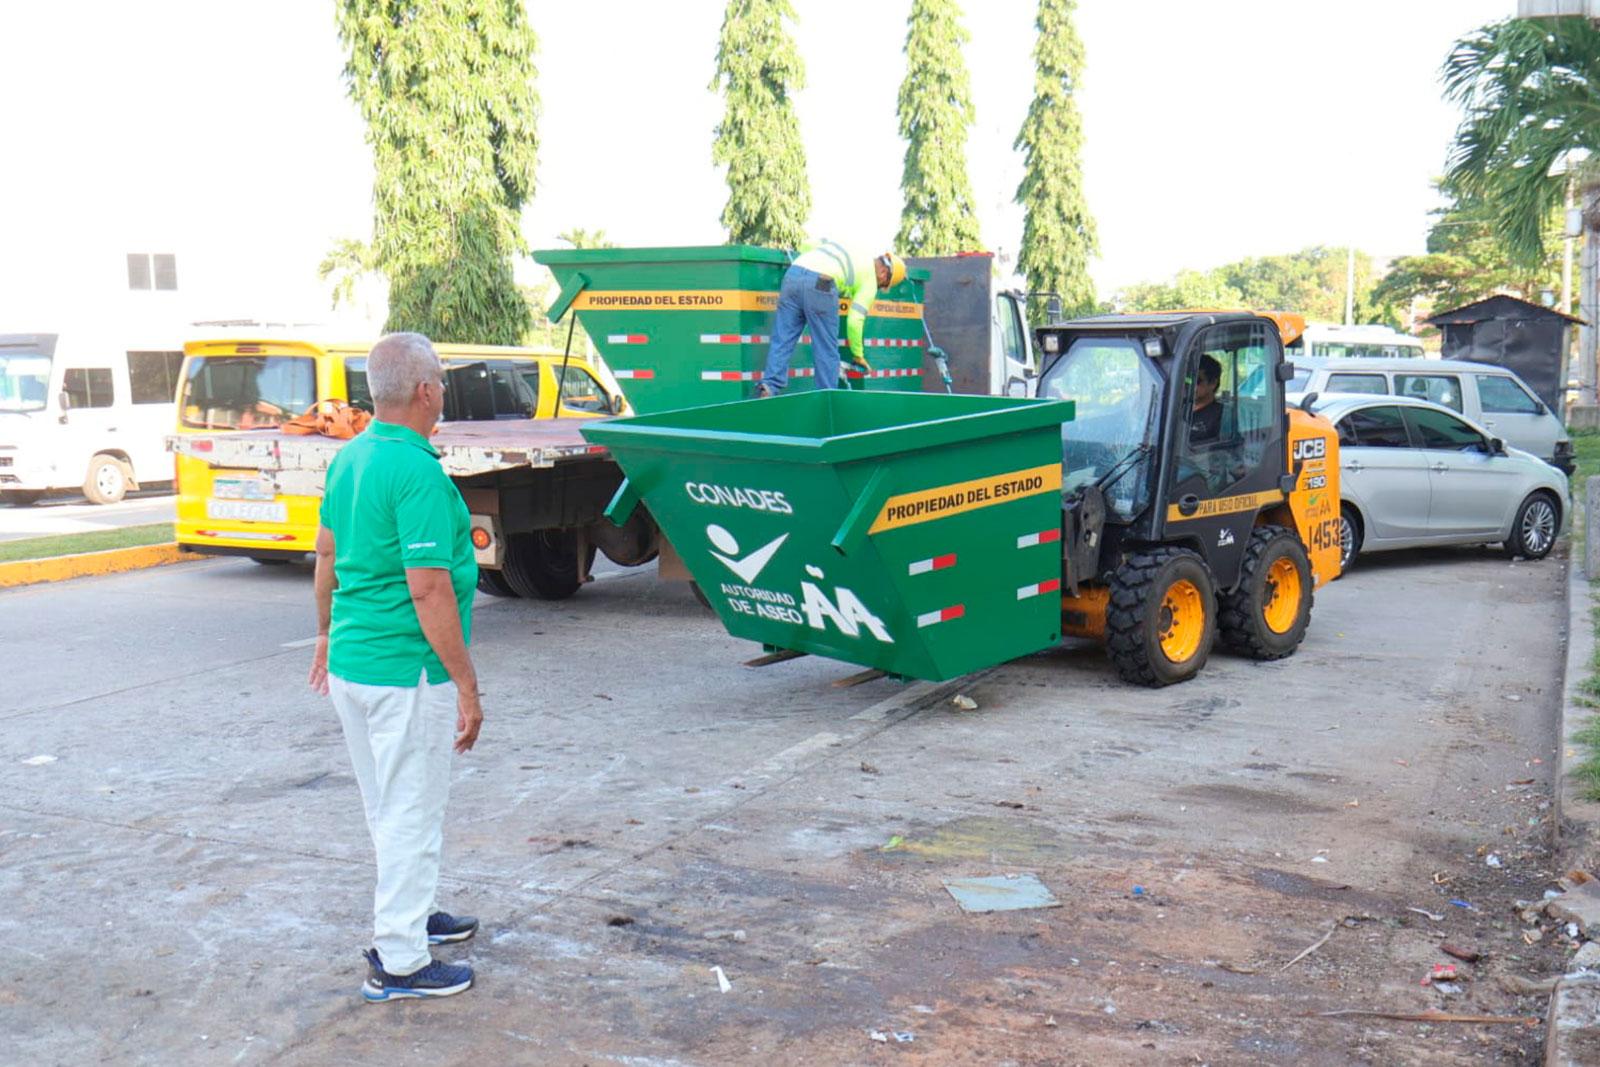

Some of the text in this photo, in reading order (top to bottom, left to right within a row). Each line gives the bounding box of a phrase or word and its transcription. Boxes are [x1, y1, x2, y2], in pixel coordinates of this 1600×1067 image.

[589, 295, 723, 305] PROPIEDAD DEL ESTADO
[1293, 438, 1325, 460] JCB
[685, 481, 793, 514] CONADES
[887, 475, 1043, 522] PROPIEDAD DEL ESTADO
[1199, 500, 1217, 514] PARA
[1308, 517, 1341, 554] 1453
[720, 583, 796, 606] AUTORIDAD
[727, 597, 804, 625] DE ASEO
